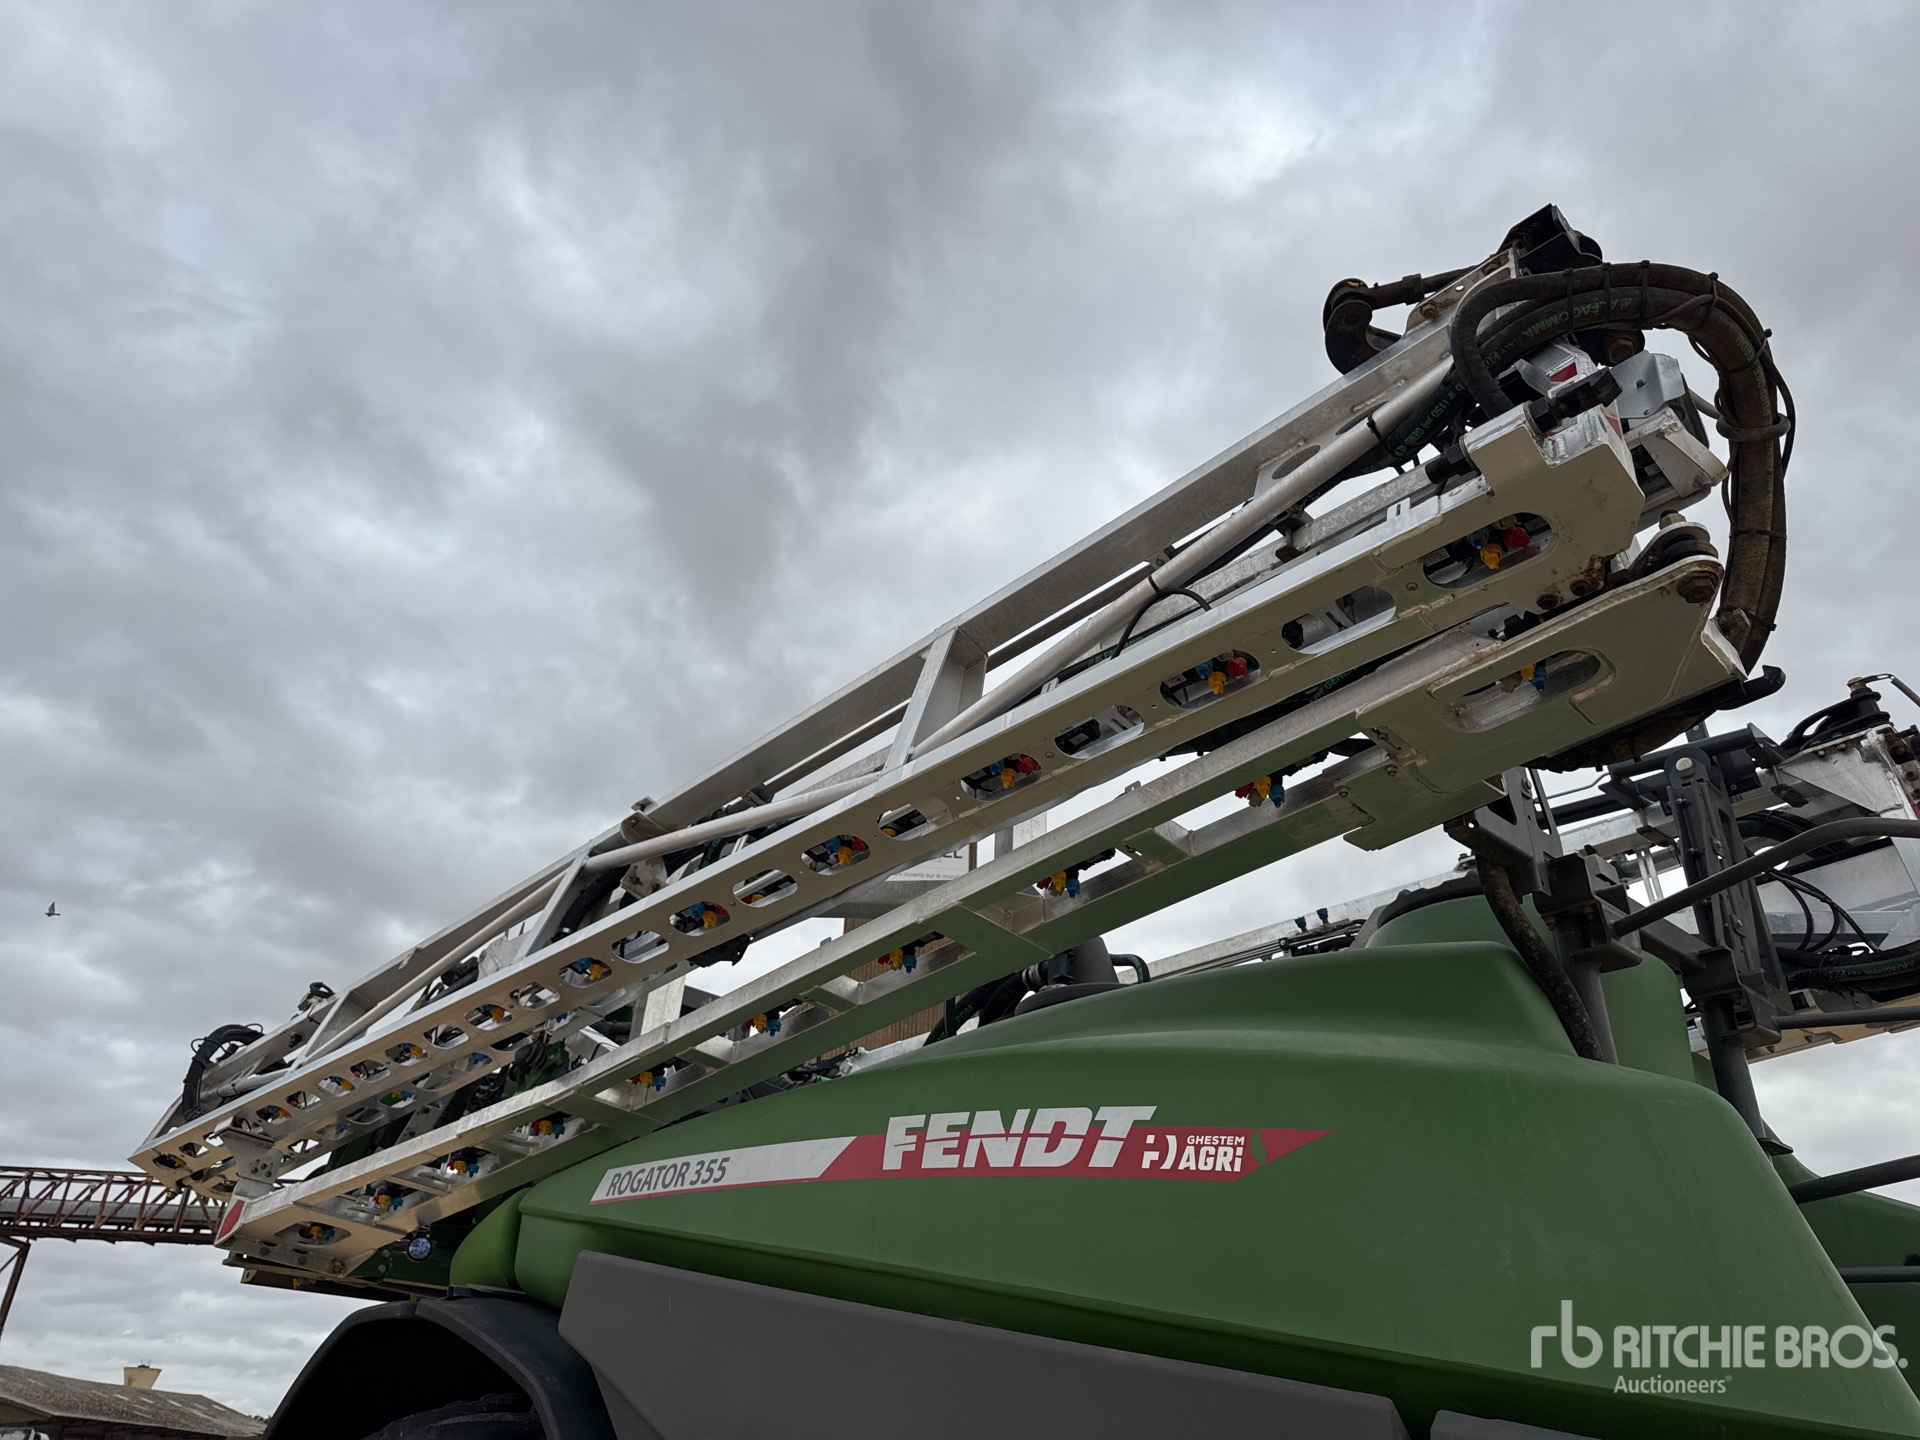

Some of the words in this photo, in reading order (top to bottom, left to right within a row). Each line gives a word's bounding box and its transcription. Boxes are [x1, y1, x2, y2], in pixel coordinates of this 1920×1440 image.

[882, 1106, 1158, 1171] FENDT
[1186, 1135, 1245, 1146] GHESTEM
[605, 1161, 691, 1197] ROGATOR
[689, 1156, 731, 1186] 355
